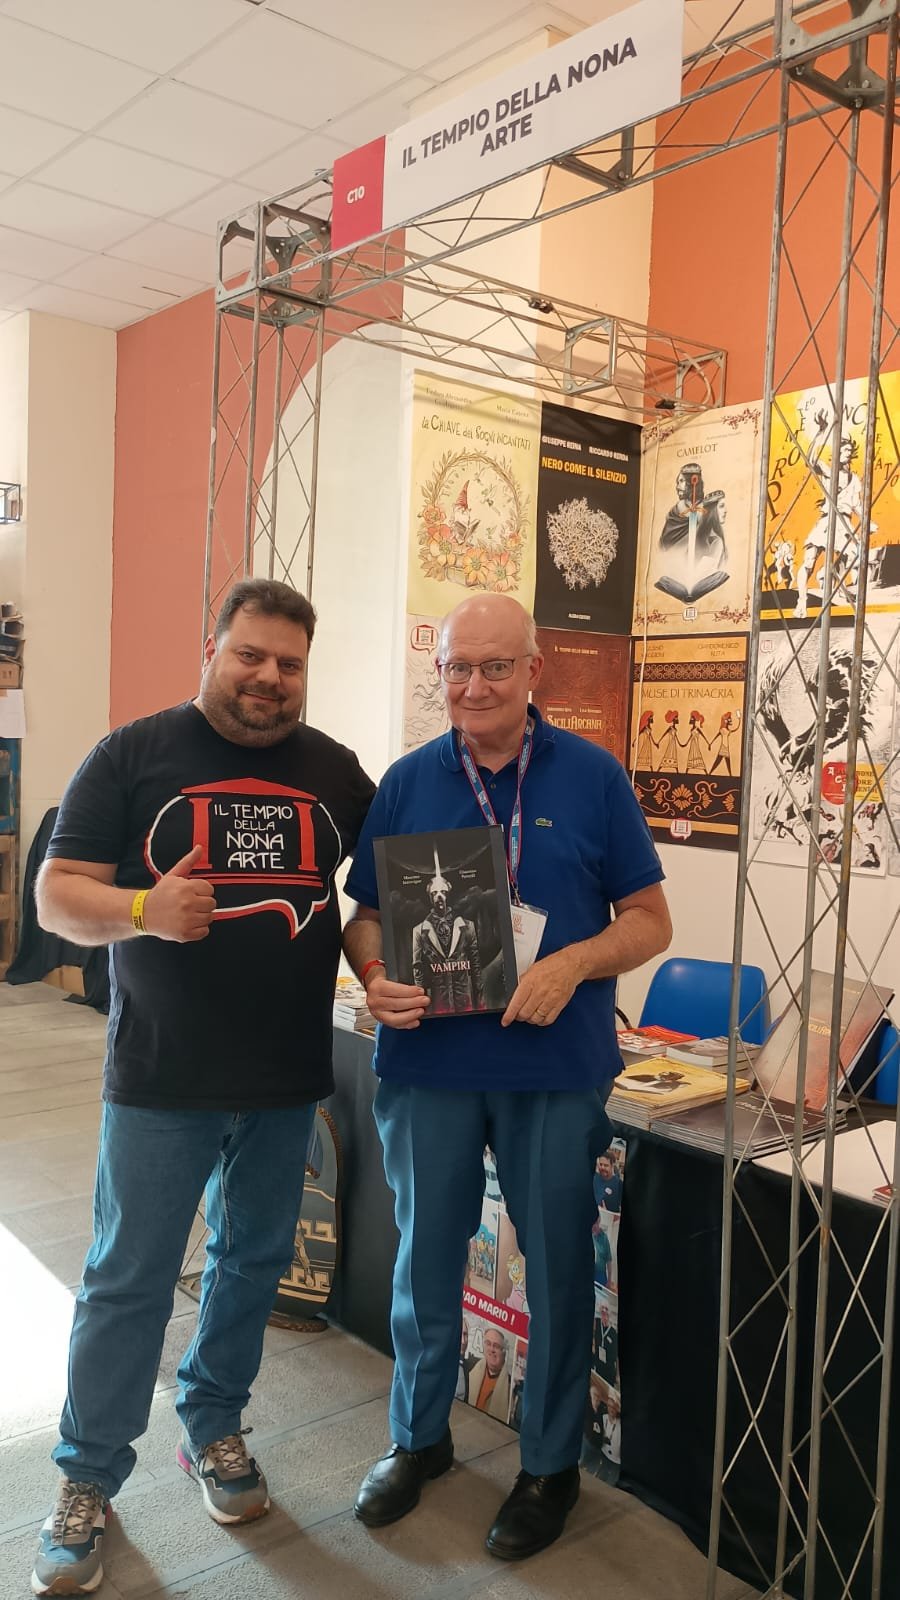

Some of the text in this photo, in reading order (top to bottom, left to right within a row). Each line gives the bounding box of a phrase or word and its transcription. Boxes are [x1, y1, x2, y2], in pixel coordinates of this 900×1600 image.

[402, 37, 637, 169] IL TEMPIO DELLA NONA
[480, 113, 533, 157] ARTE
[347, 185, 365, 204] C10
[542, 435, 566, 448] GIUSEPPE
[676, 443, 718, 458] CAMELOT
[542, 456, 627, 484] NERO COME IL SILENZIO
[641, 688, 734, 698] MUSE DI TRINACRIA
[214, 804, 293, 819] IL TEMPIO
[234, 819, 275, 831] DELLA
[226, 831, 284, 850] NONA
[228, 851, 285, 869] ARTE
[430, 960, 471, 973] VAMPIRI
[478, 1299, 508, 1322] MARIO
